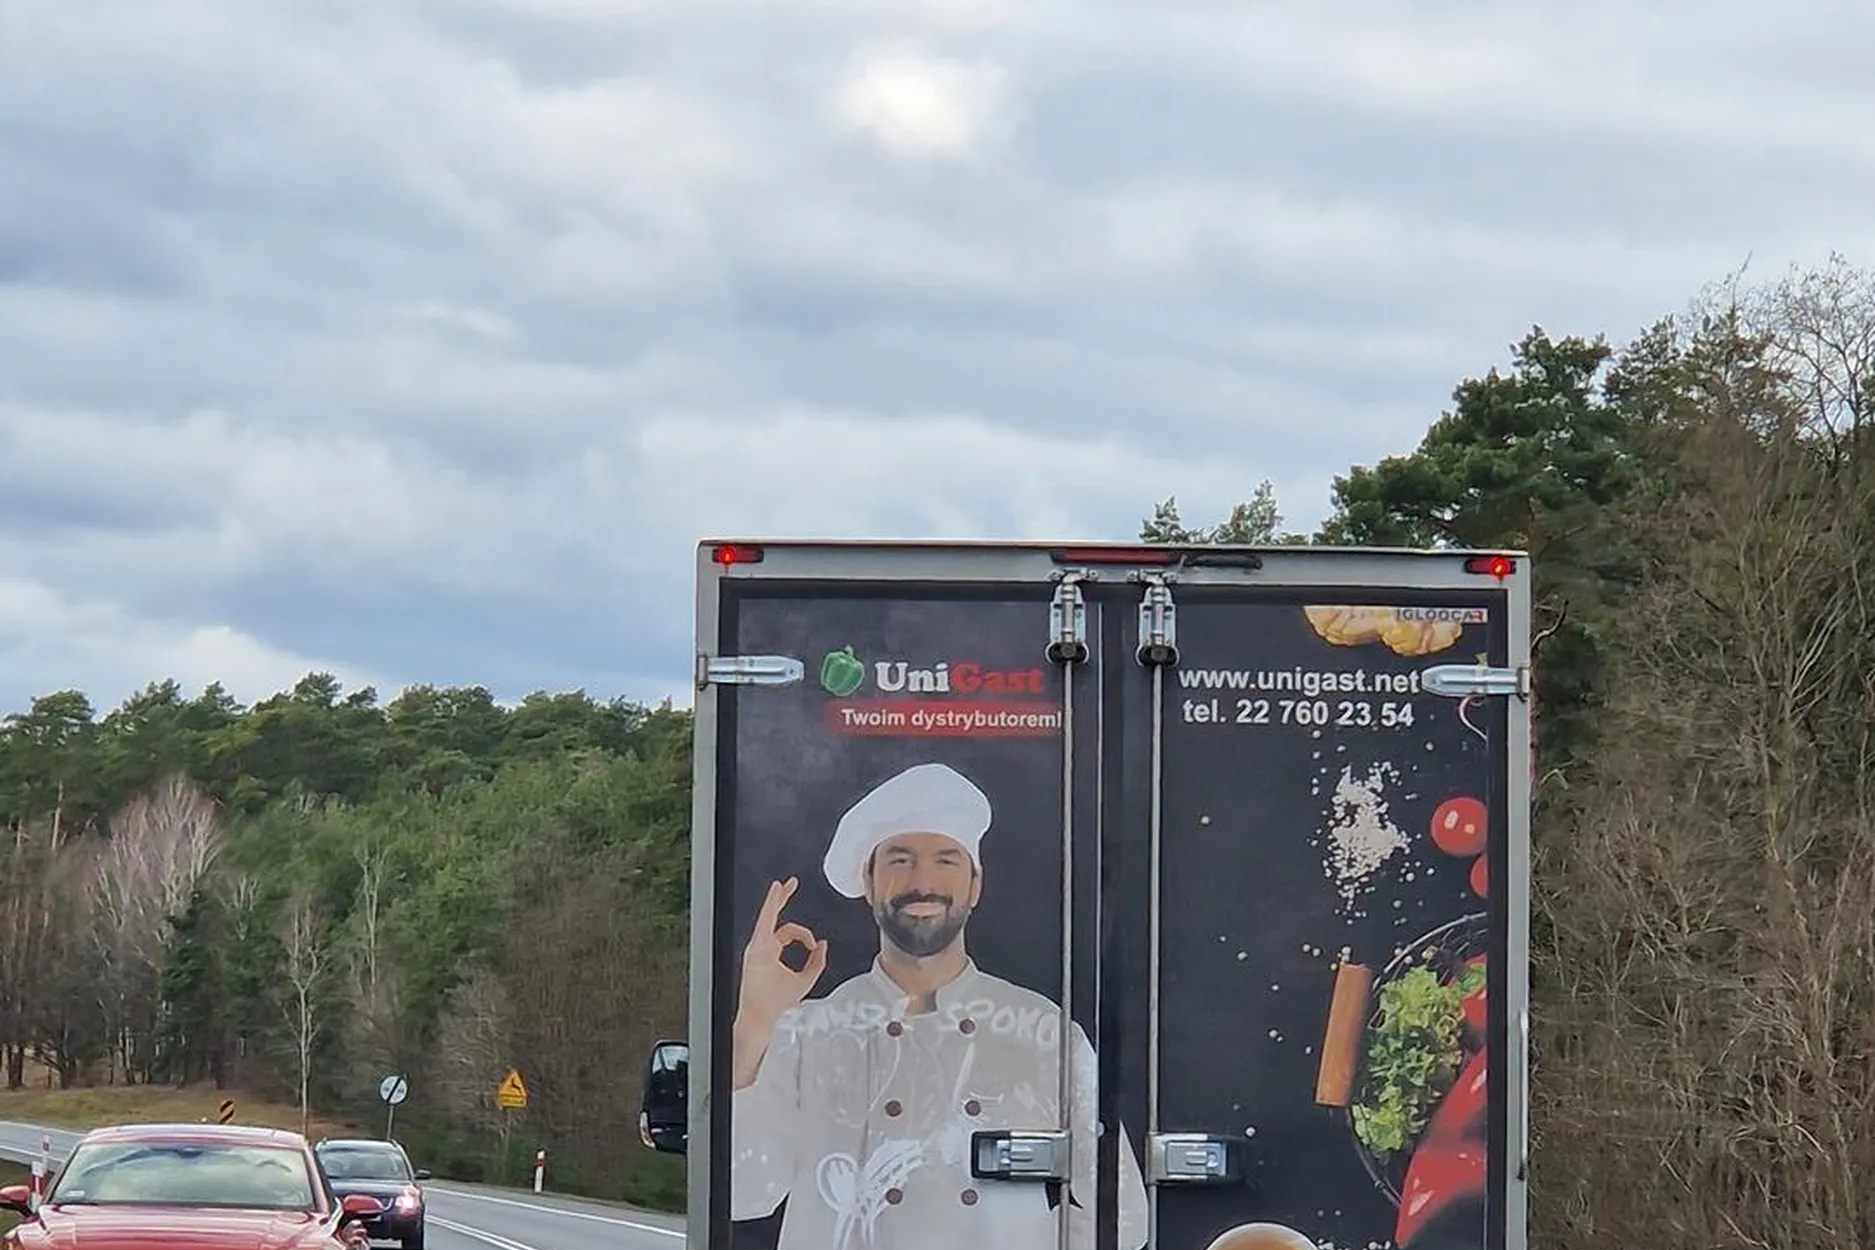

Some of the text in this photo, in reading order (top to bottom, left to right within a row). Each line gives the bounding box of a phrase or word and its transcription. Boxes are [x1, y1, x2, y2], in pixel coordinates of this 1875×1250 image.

[874, 660, 1045, 693] UniGast
[1178, 667, 1420, 695] www.unigast.net
[841, 708, 1062, 730] Twoim dystrybutorem!
[1183, 700, 1415, 727] tel. 22 760 23 54
